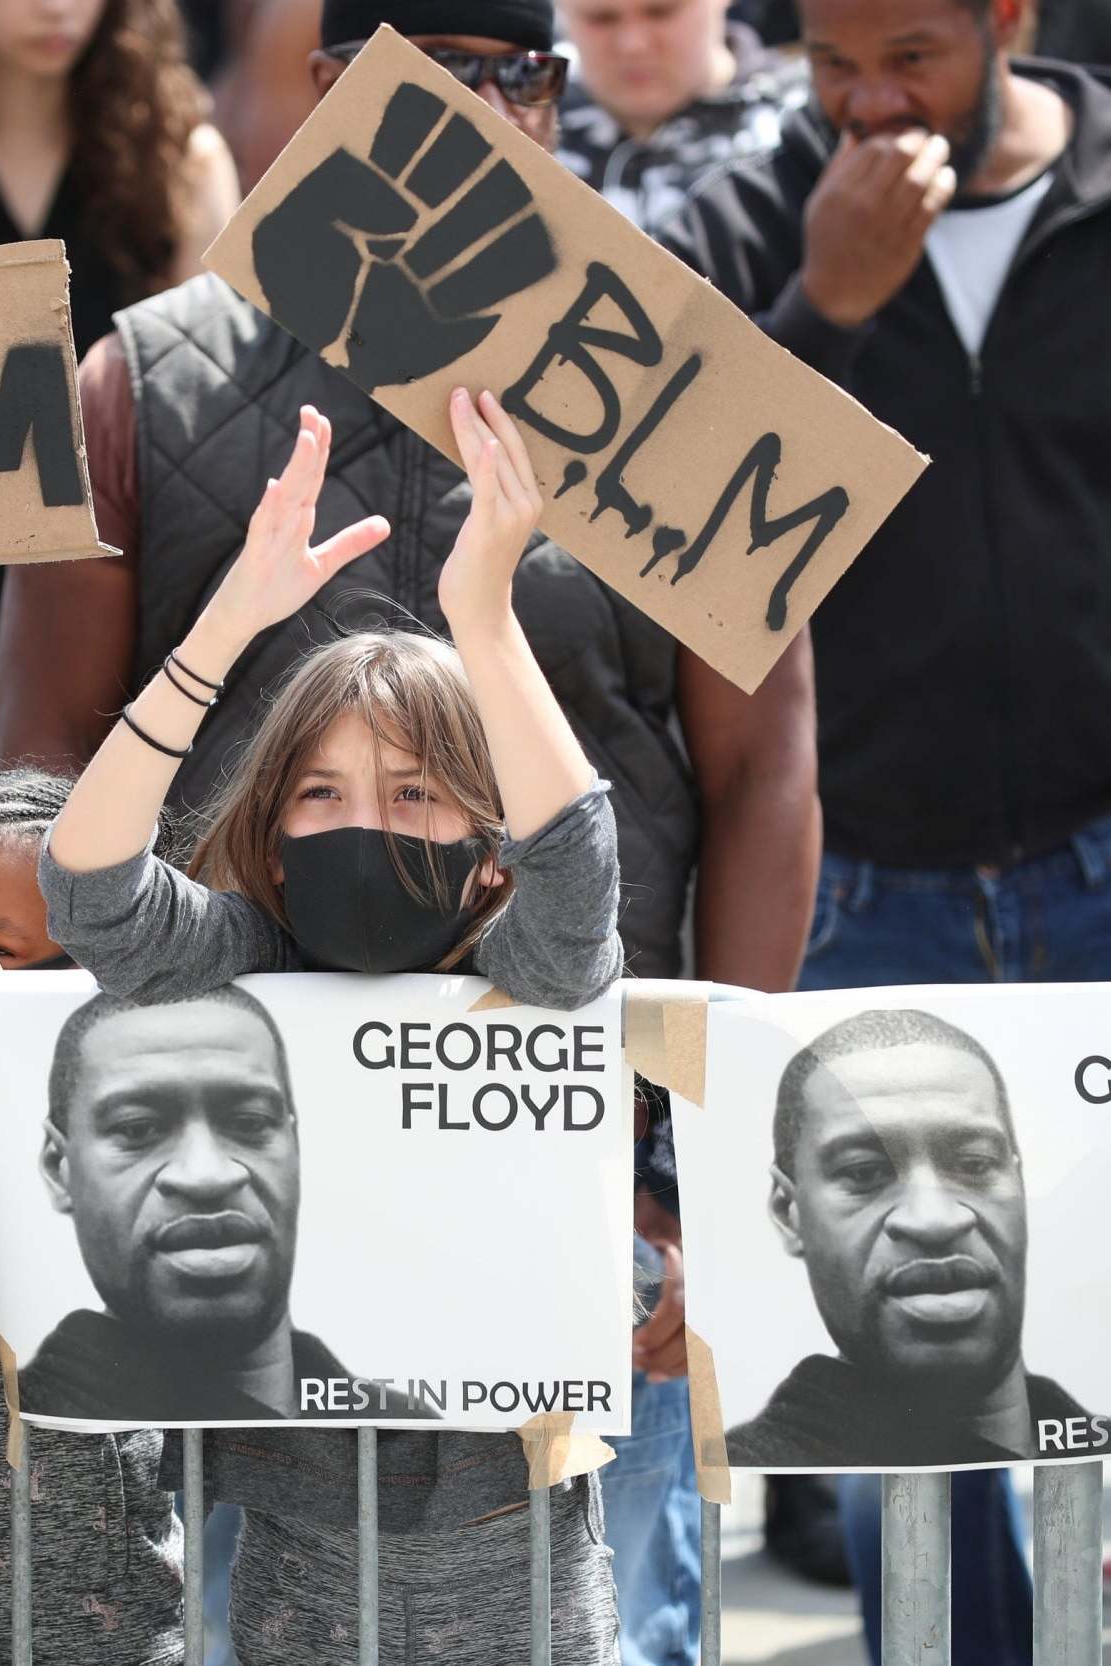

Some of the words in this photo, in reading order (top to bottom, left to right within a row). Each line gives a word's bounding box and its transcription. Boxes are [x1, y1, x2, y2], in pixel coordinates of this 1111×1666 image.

[352, 1020, 606, 1073] GEORGE
[401, 1082, 606, 1131] FLOYD
[299, 1377, 395, 1412] REST
[407, 1378, 447, 1411] IN
[461, 1379, 612, 1413] POWER
